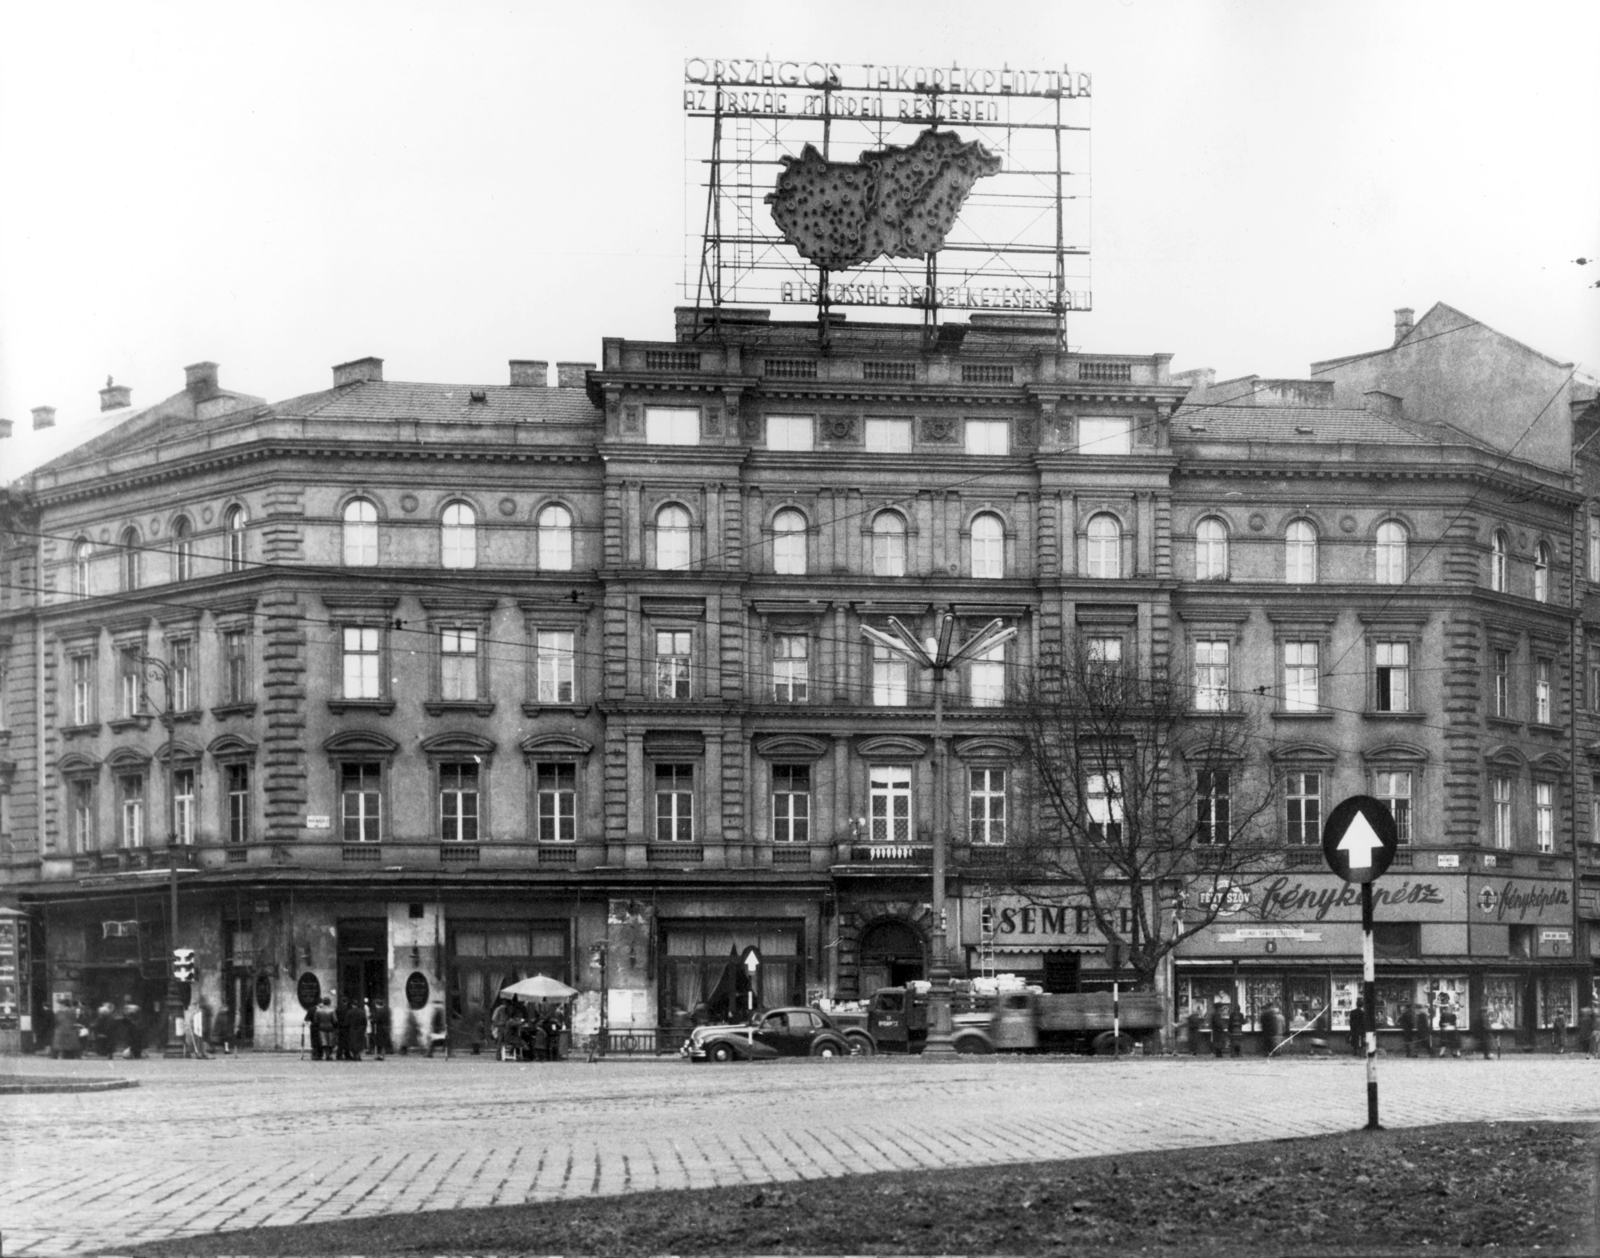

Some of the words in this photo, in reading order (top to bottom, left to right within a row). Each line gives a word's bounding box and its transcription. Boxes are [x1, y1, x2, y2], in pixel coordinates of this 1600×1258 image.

[685, 53, 842, 87] ORSZÁGOS
[862, 60, 1091, 97] TAKARÉKPÉNZTÁR
[684, 90, 706, 110] AZ
[716, 89, 787, 114] ORSZÁG
[804, 95, 883, 117] MNDEN
[783, 282, 793, 301] A
